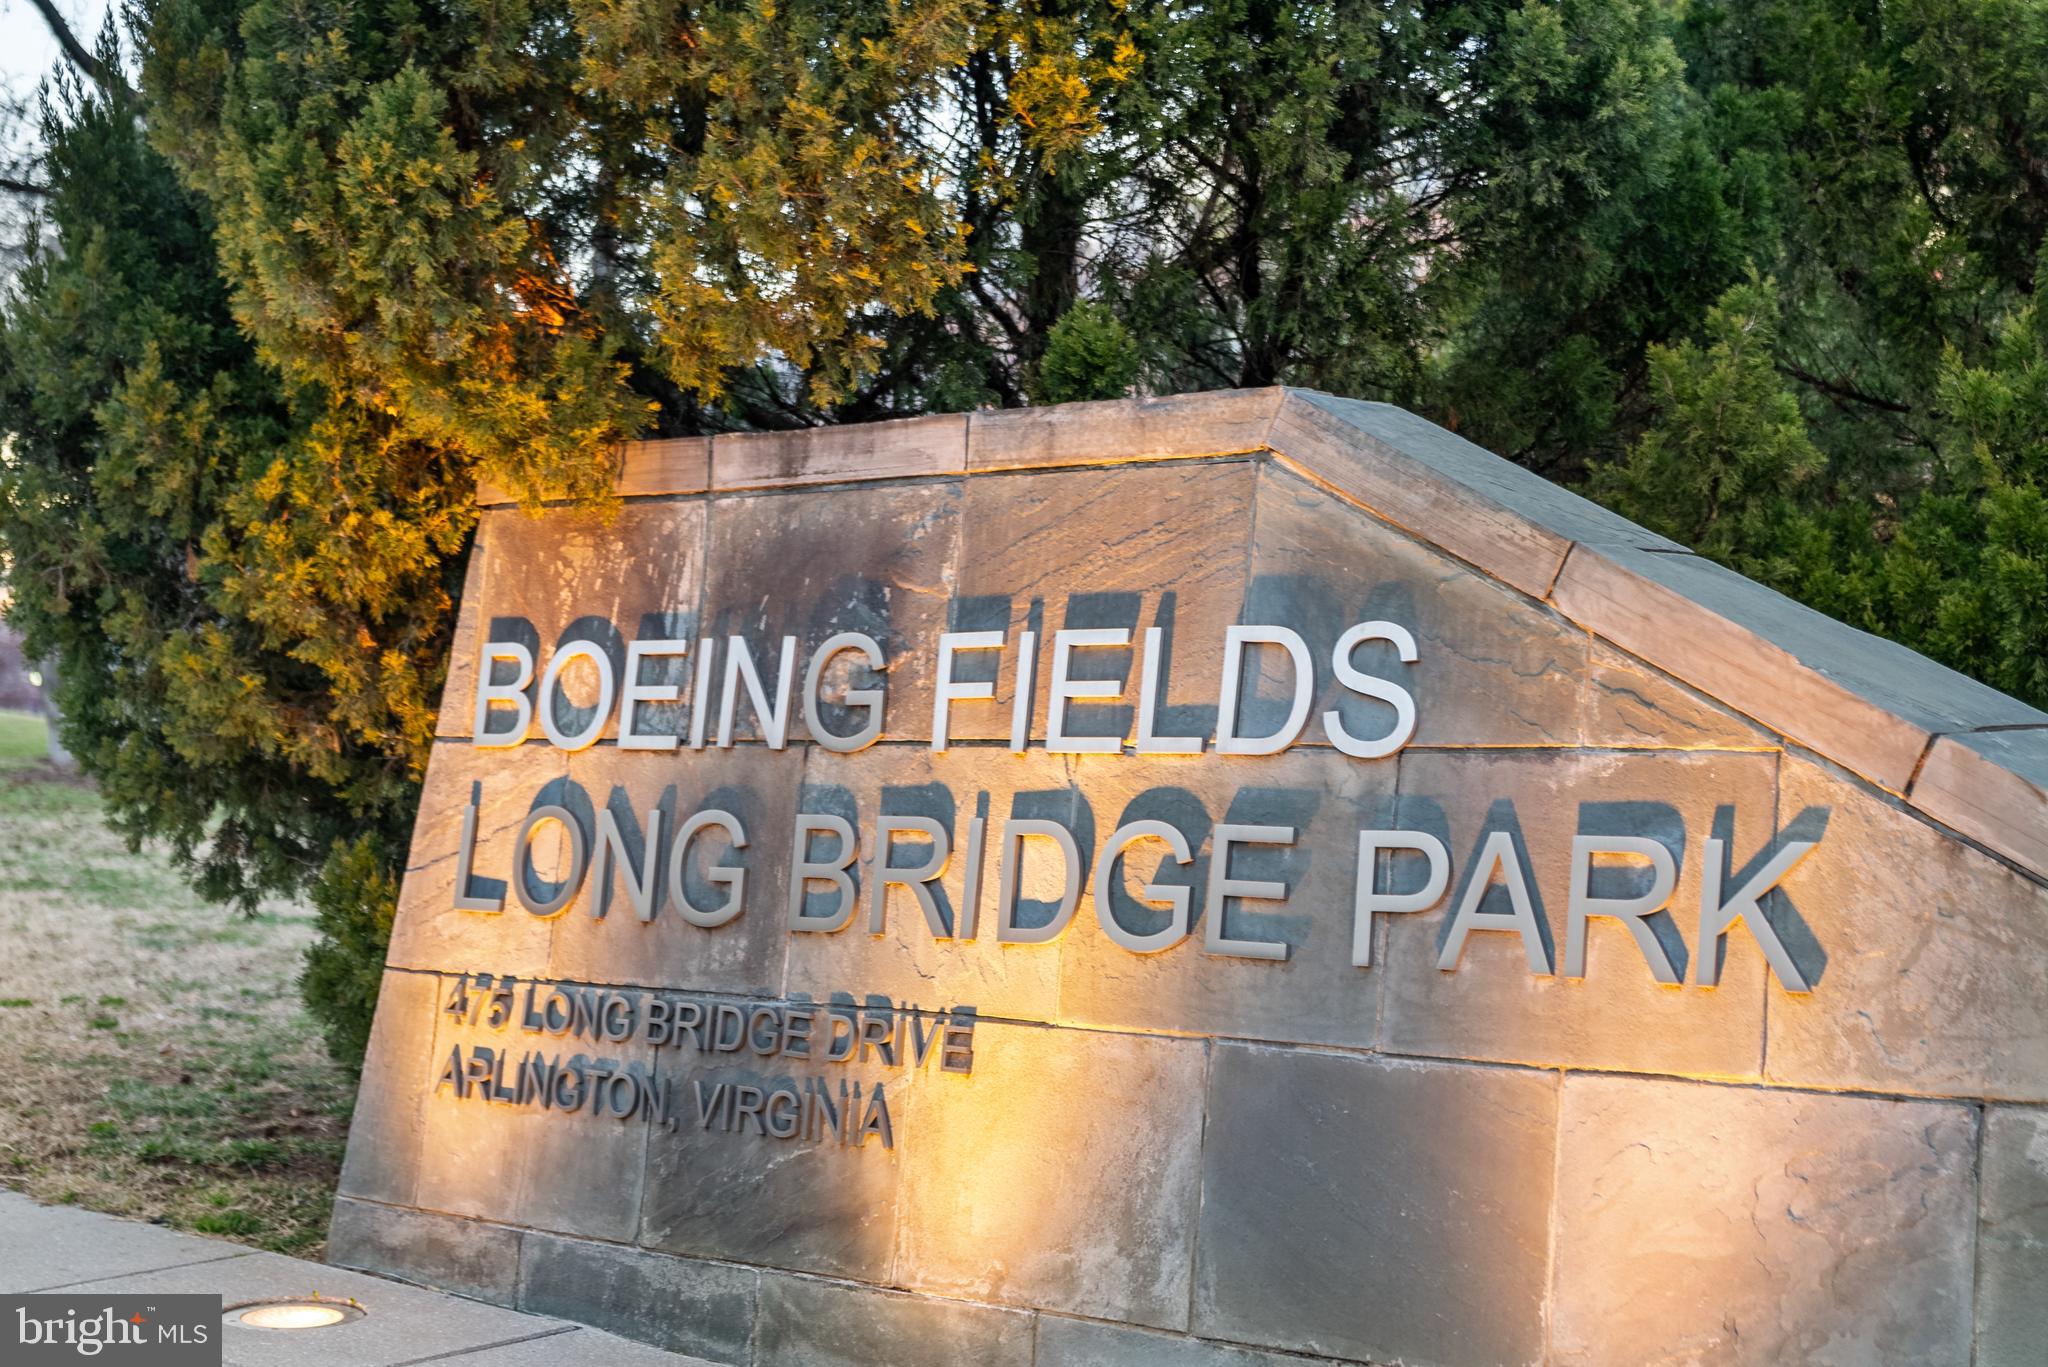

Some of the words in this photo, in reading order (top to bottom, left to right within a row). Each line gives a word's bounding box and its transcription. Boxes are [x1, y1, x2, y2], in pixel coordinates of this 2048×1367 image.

[473, 632, 888, 753] BOEING
[931, 620, 1418, 760] FIELDS
[454, 804, 749, 928] LONG
[788, 813, 1296, 961] BRIDGE
[1352, 829, 1820, 994] PARK
[444, 980, 514, 1030] 475
[521, 988, 634, 1043] LONG
[646, 1000, 814, 1061] BRIDGE
[824, 1009, 975, 1075] DRIVE
[434, 1055, 680, 1134] ARLINGTON,
[693, 1080, 894, 1150] VIRGINIA
